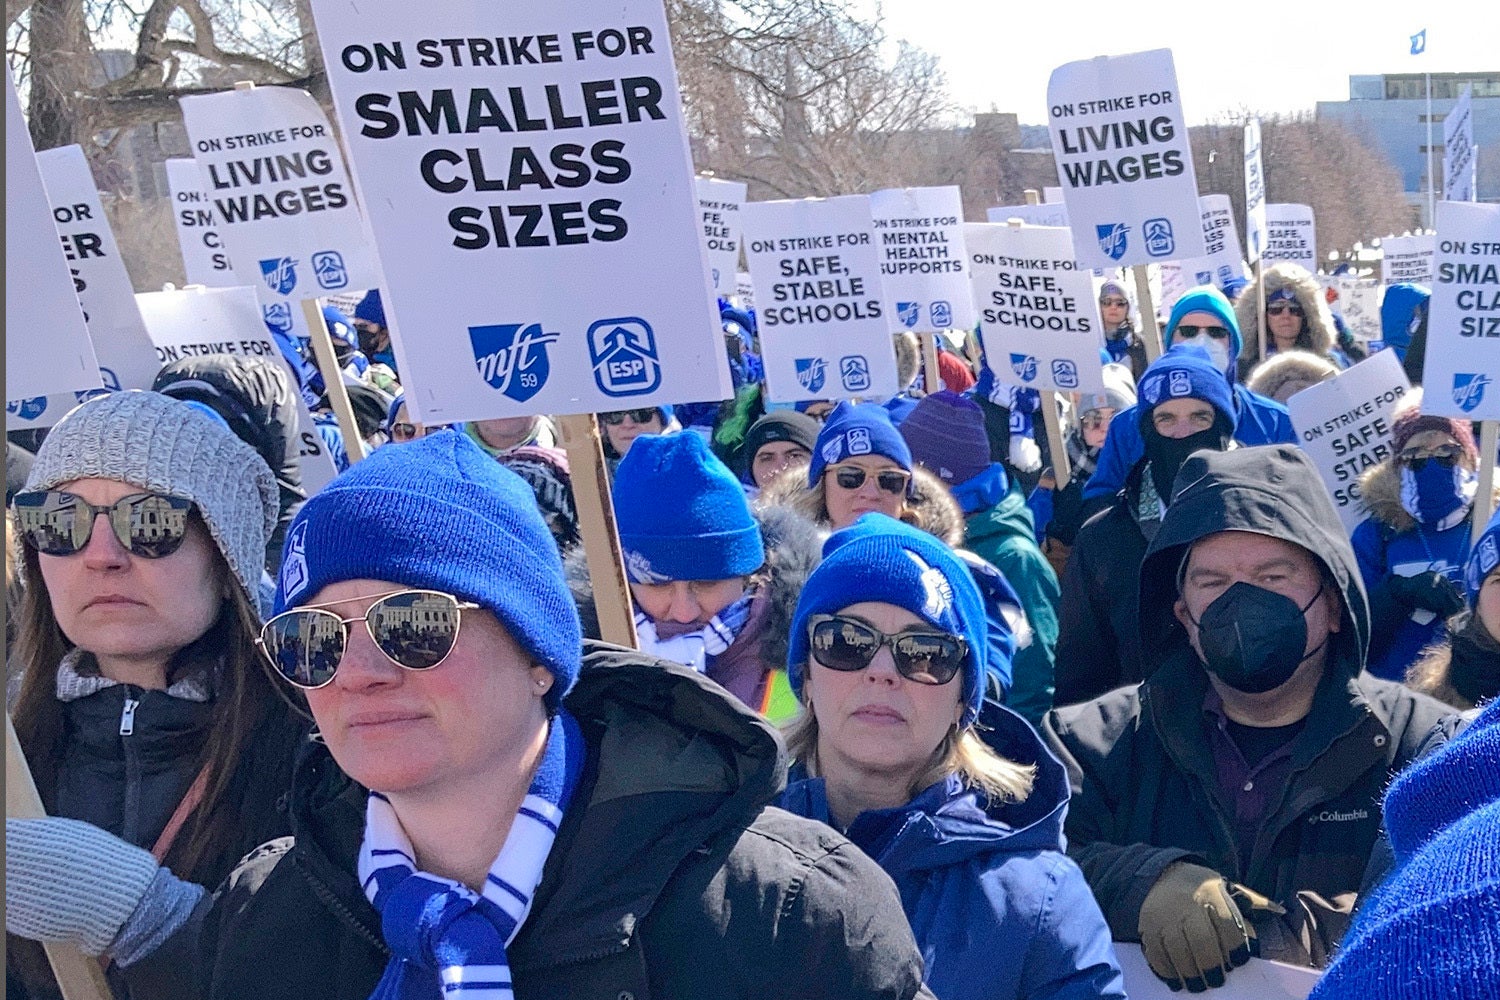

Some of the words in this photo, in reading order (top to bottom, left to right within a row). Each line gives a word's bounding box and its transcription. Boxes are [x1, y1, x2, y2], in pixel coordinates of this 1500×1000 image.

[342, 42, 406, 72] ON
[417, 34, 562, 68] STRIKE
[572, 26, 654, 61] FOR
[355, 77, 666, 139] SMALLER
[1052, 104, 1074, 118] ON
[1079, 96, 1134, 115] STRIKE
[1138, 91, 1173, 107] FOR
[199, 139, 222, 153] ON
[226, 130, 286, 150] STRIKE
[292, 125, 326, 140] FOR
[1059, 116, 1174, 155] LIVING
[209, 150, 332, 190] LIVING
[420, 140, 631, 193] CLASS
[1062, 150, 1184, 188] WAGES
[178, 191, 199, 202] ON
[215, 184, 348, 224] WAGES
[54, 203, 93, 224] OR
[448, 199, 628, 249] SIZES
[703, 212, 724, 226] FE,
[891, 218, 930, 228] STRIKE
[933, 216, 957, 226] FOR
[704, 225, 729, 238] BLE
[1202, 219, 1230, 232] LLER
[752, 240, 775, 253] ON
[780, 235, 832, 251] STRIKE
[838, 233, 869, 246] FOR
[883, 231, 948, 244] MENTAL
[1440, 241, 1465, 254] ON
[887, 246, 948, 259] HEALTH
[973, 254, 995, 265] ON
[999, 256, 1047, 270] STRIKE
[780, 255, 850, 277] SAFE,
[773, 277, 864, 302] STABLE
[999, 272, 1063, 294] SAFE,
[764, 300, 881, 326] SCHOOLS
[992, 291, 1076, 313] STABLE
[983, 309, 1091, 333] SCHOOLS
[243, 340, 275, 356] FOR
[477, 323, 560, 393] mft
[611, 360, 643, 378] ESP
[521, 373, 538, 388] 59
[1303, 426, 1321, 442] ON
[1325, 402, 1374, 434] STRIKE
[1376, 385, 1405, 409] FOR
[1334, 445, 1395, 481] STAB
[1320, 808, 1368, 823] Columbia
